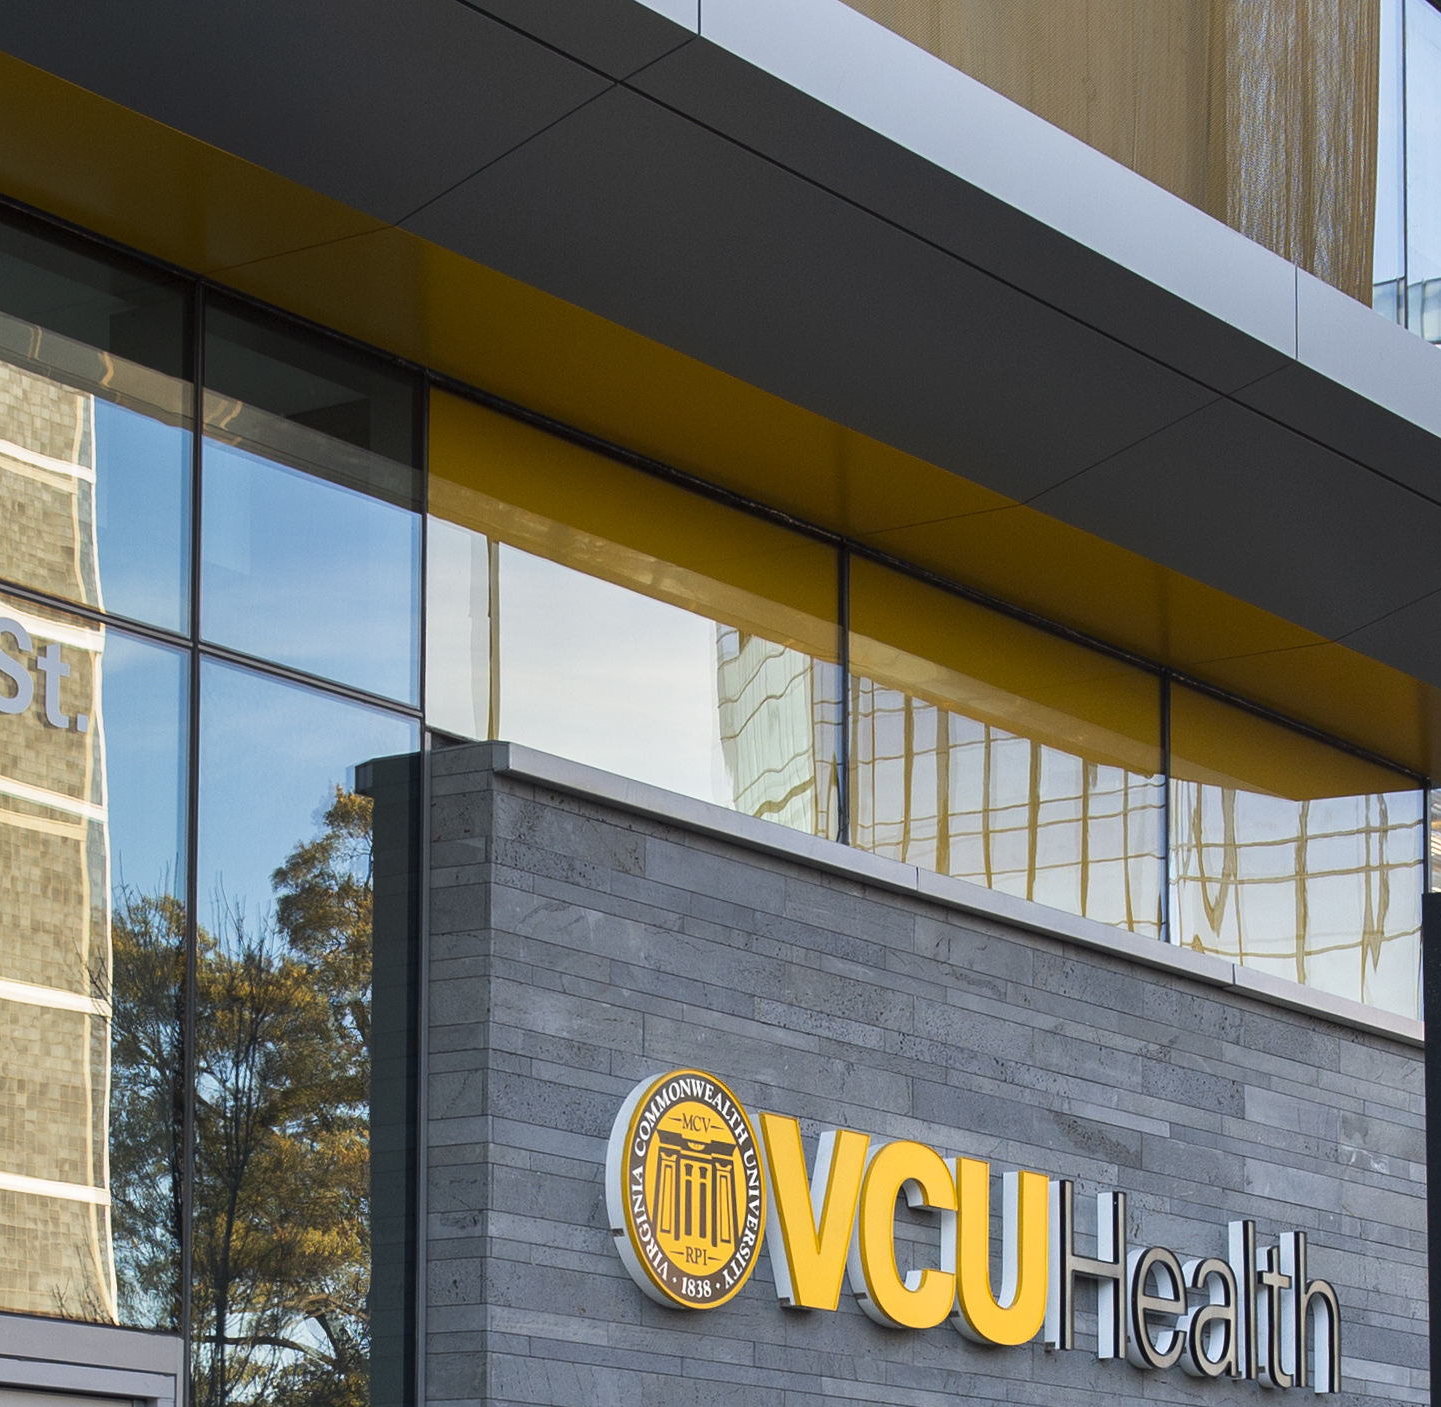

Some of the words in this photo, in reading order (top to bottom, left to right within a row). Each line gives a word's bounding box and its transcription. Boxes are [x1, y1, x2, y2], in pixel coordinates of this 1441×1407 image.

[634, 1078, 749, 1157] COMMONWEALTH
[681, 1112, 711, 1134] MCV
[631, 1164, 669, 1282] VIRGINIA
[685, 1245, 708, 1267] RPI
[723, 1147, 760, 1290] UNIVERSITY
[757, 1110, 1050, 1346] VCU
[1049, 1178, 1343, 1395] Health
[681, 1276, 712, 1298] 1838
